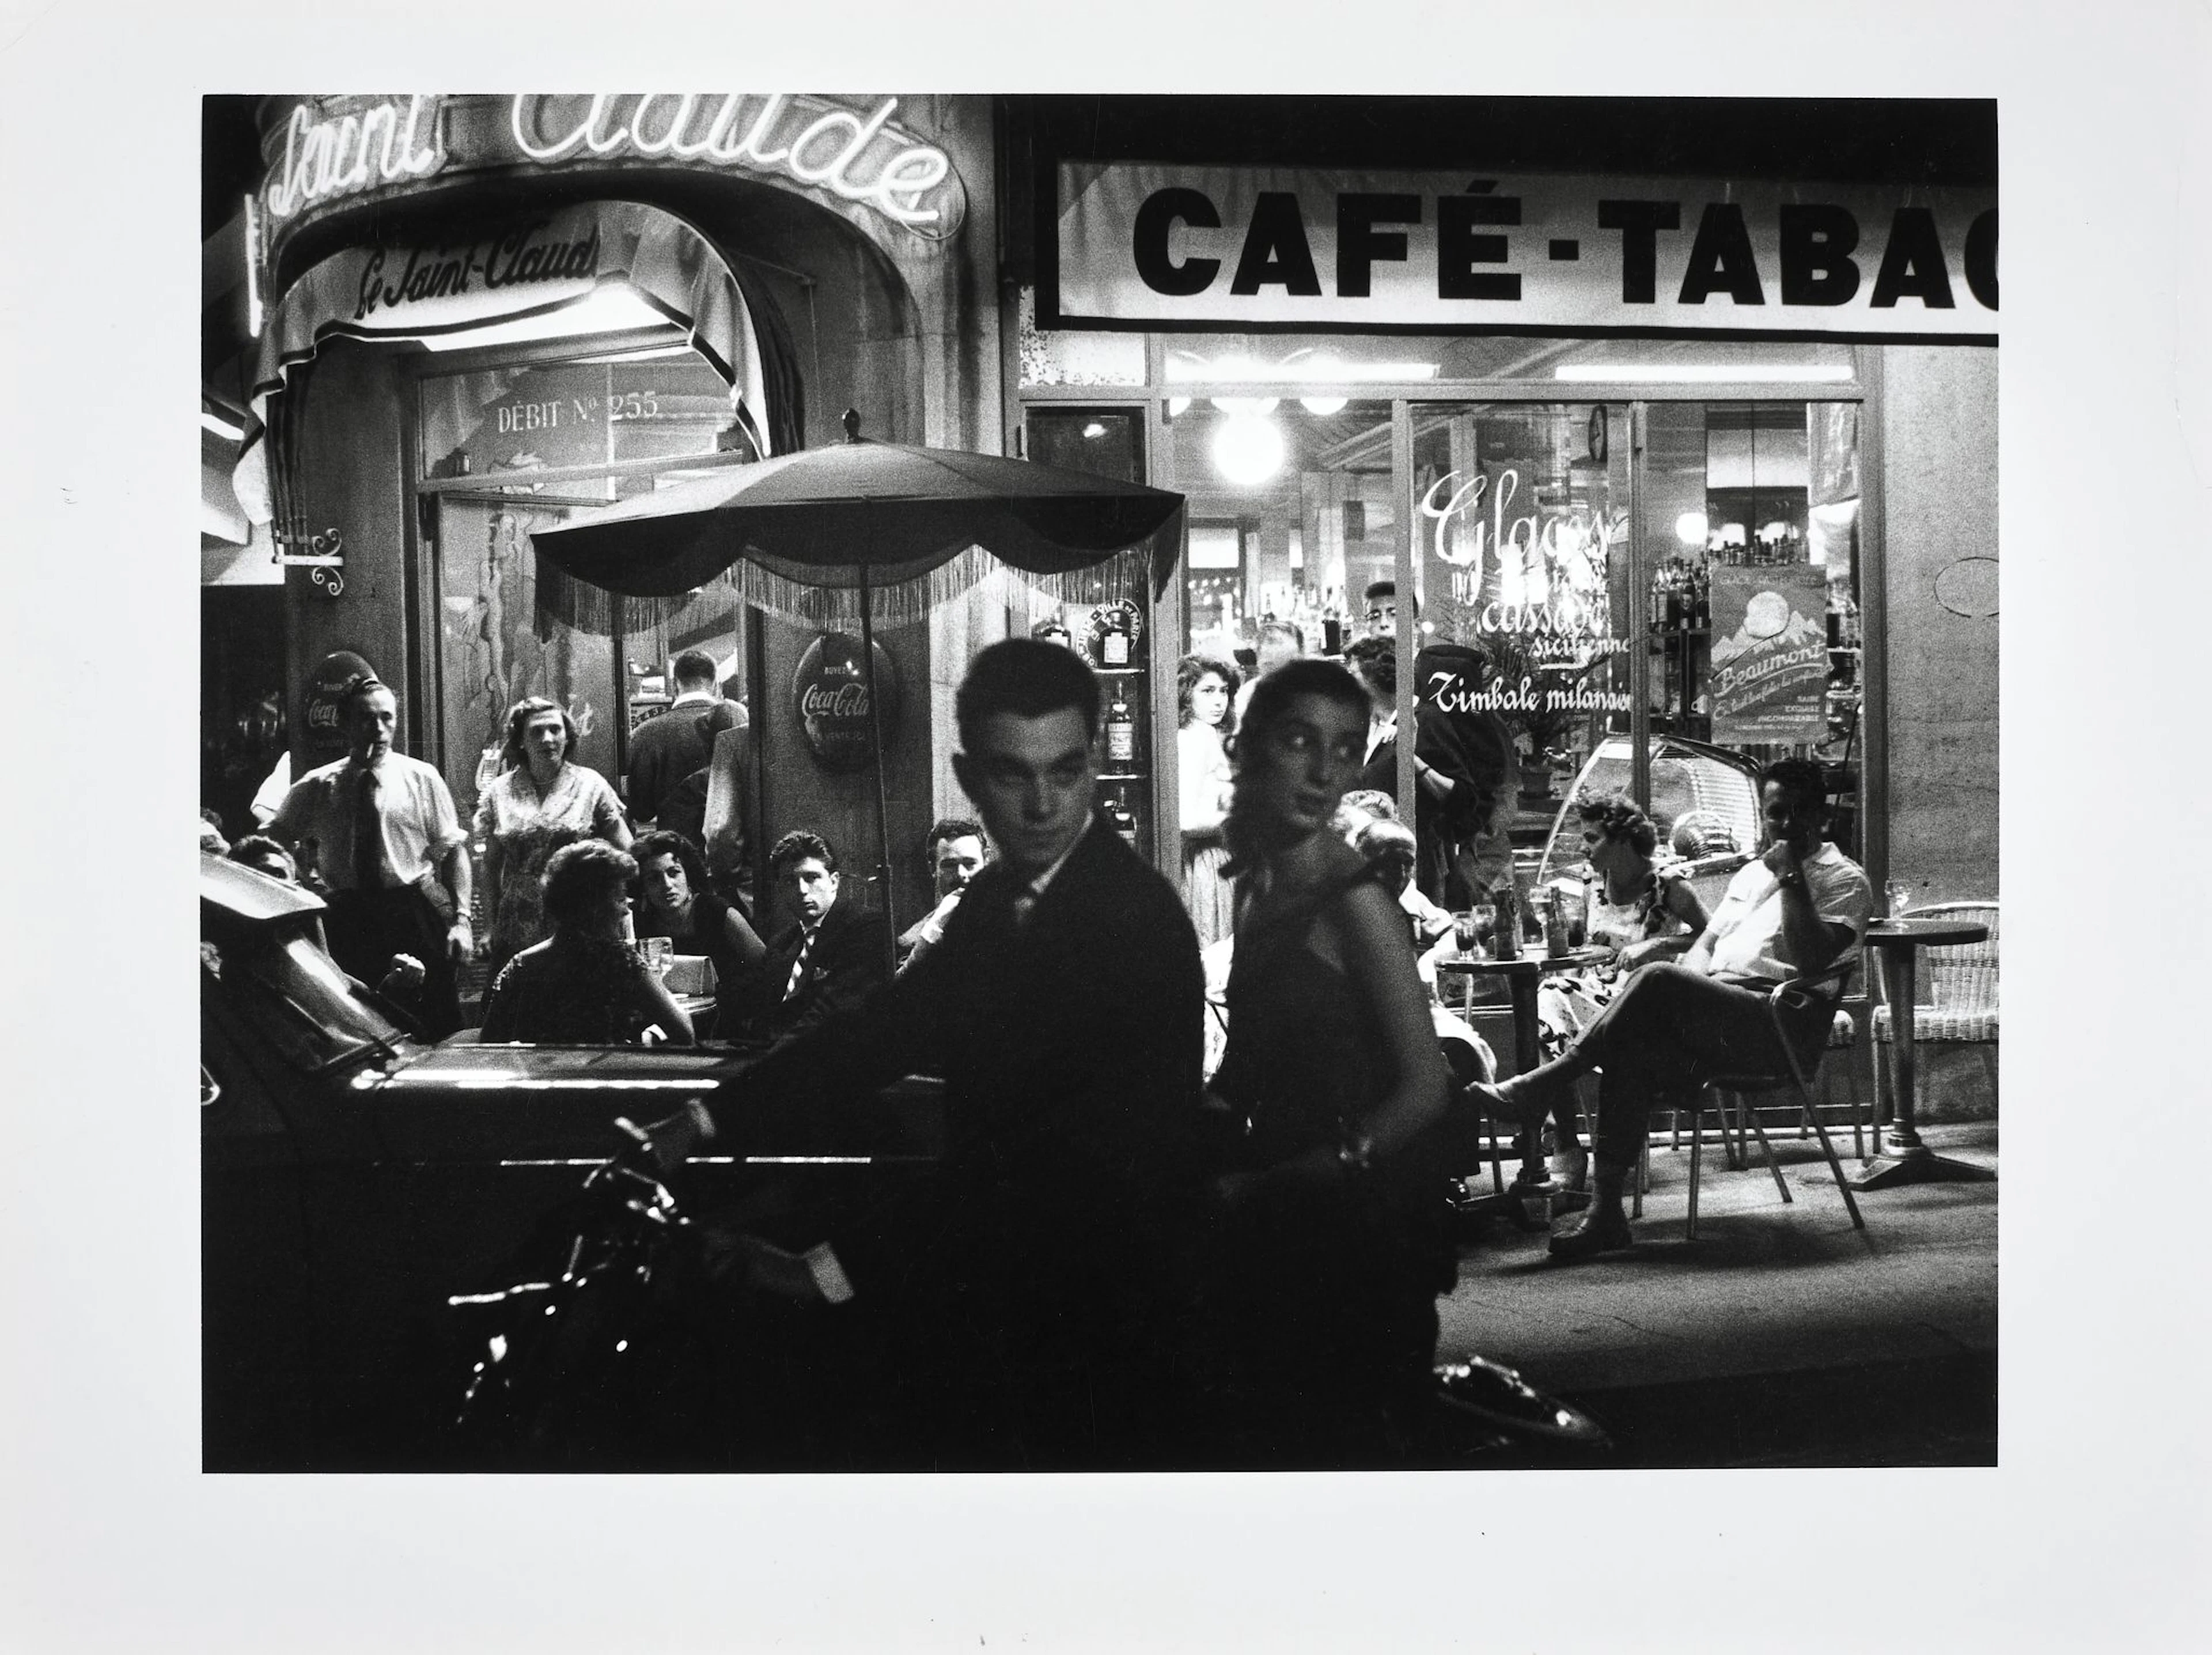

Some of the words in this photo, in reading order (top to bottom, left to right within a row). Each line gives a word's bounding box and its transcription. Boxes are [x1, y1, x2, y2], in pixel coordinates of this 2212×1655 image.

[512, 94, 948, 221] Claude
[498, 400, 560, 433] DÉBIT
[609, 391, 658, 421] 255
[1713, 640, 1827, 698] Beaumont
[801, 683, 869, 717] Coca-Cola
[1428, 672, 1540, 713] Timbale
